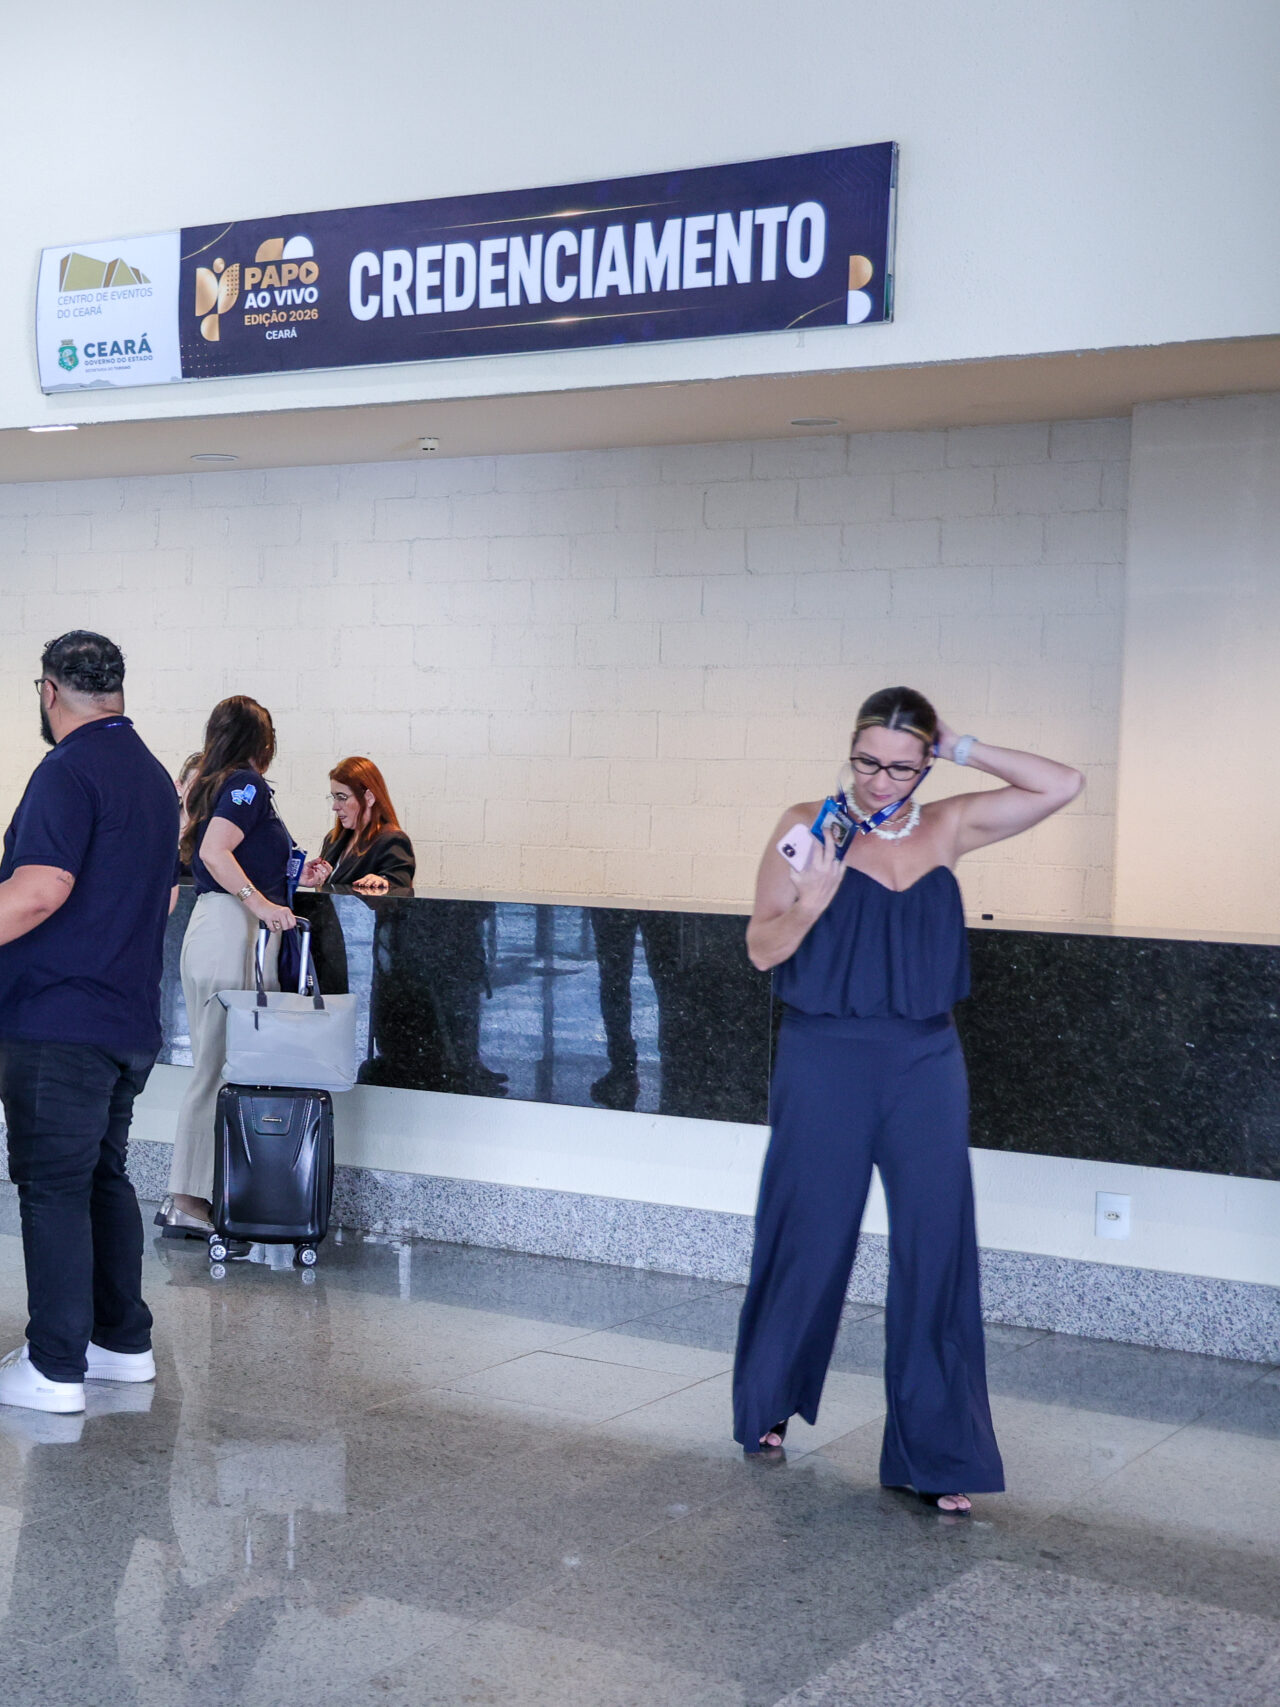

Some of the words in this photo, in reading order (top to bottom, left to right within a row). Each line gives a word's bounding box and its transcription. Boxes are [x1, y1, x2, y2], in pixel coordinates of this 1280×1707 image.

[349, 201, 826, 321] CREDENCIAMENTO
[244, 261, 319, 290] PAPO
[57, 293, 94, 305] CENTRO
[96, 292, 109, 302] DE
[110, 287, 153, 300] EVENTOS
[244, 291, 271, 309] AO
[274, 286, 318, 306] VIVO
[57, 308, 71, 319] DO
[72, 304, 102, 318] CEARÁ
[244, 309, 288, 327] EDIÇÃO
[289, 308, 319, 322] 2026
[265, 326, 298, 340] CEARÁ
[83, 332, 152, 358] CEARÁ
[84, 357, 115, 366] GOVERNO
